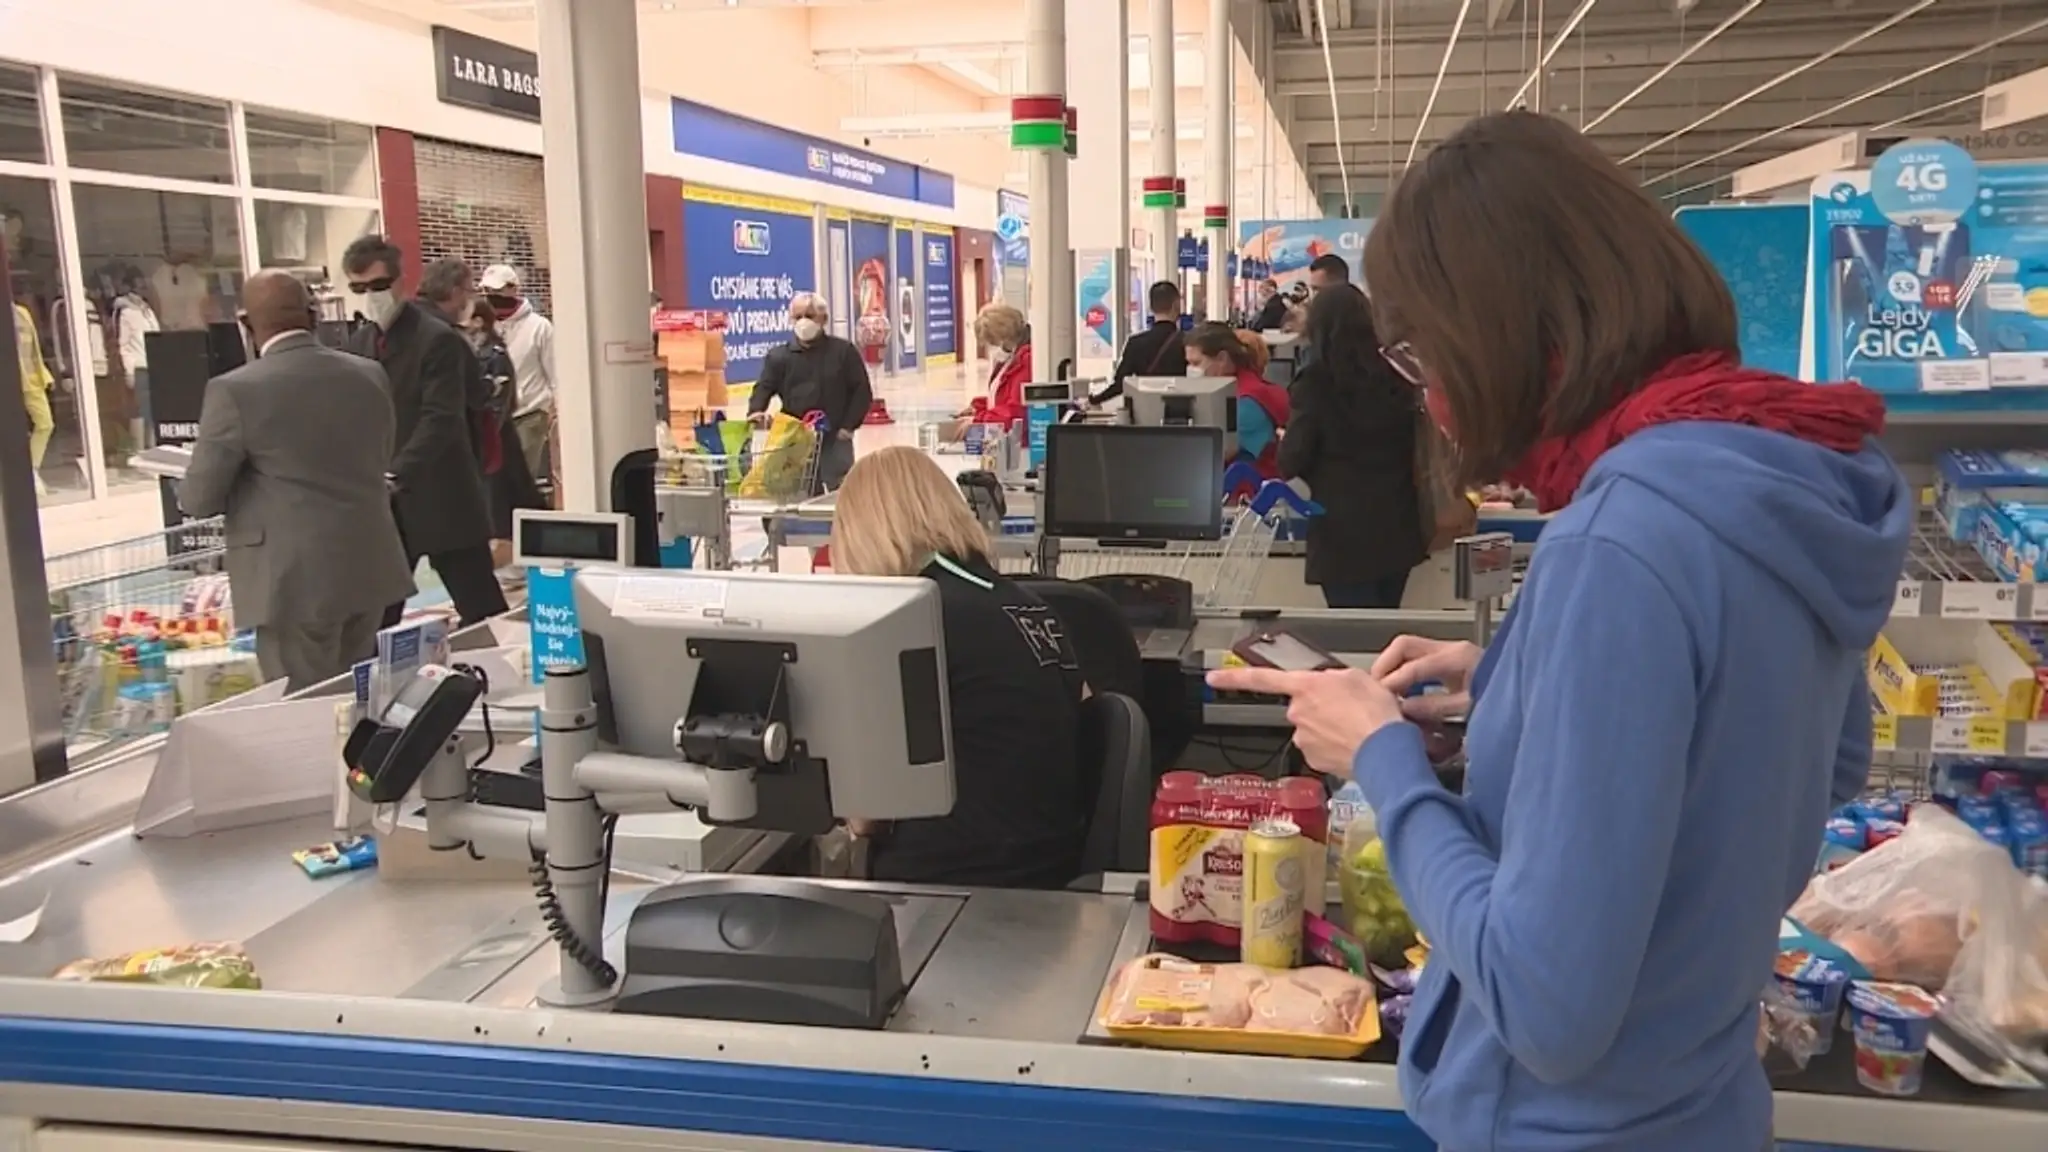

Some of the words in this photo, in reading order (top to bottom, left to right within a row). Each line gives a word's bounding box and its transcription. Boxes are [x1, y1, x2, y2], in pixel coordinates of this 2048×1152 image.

[453, 55, 498, 88] LARA
[502, 67, 541, 98] BAGS
[1896, 163, 1948, 192] 4G
[711, 271, 760, 300] CHYSTÁME
[761, 276, 776, 300] PRE
[777, 272, 794, 300] VÁS
[1868, 303, 1932, 331] Lejdy
[1859, 328, 1946, 358] GIGA
